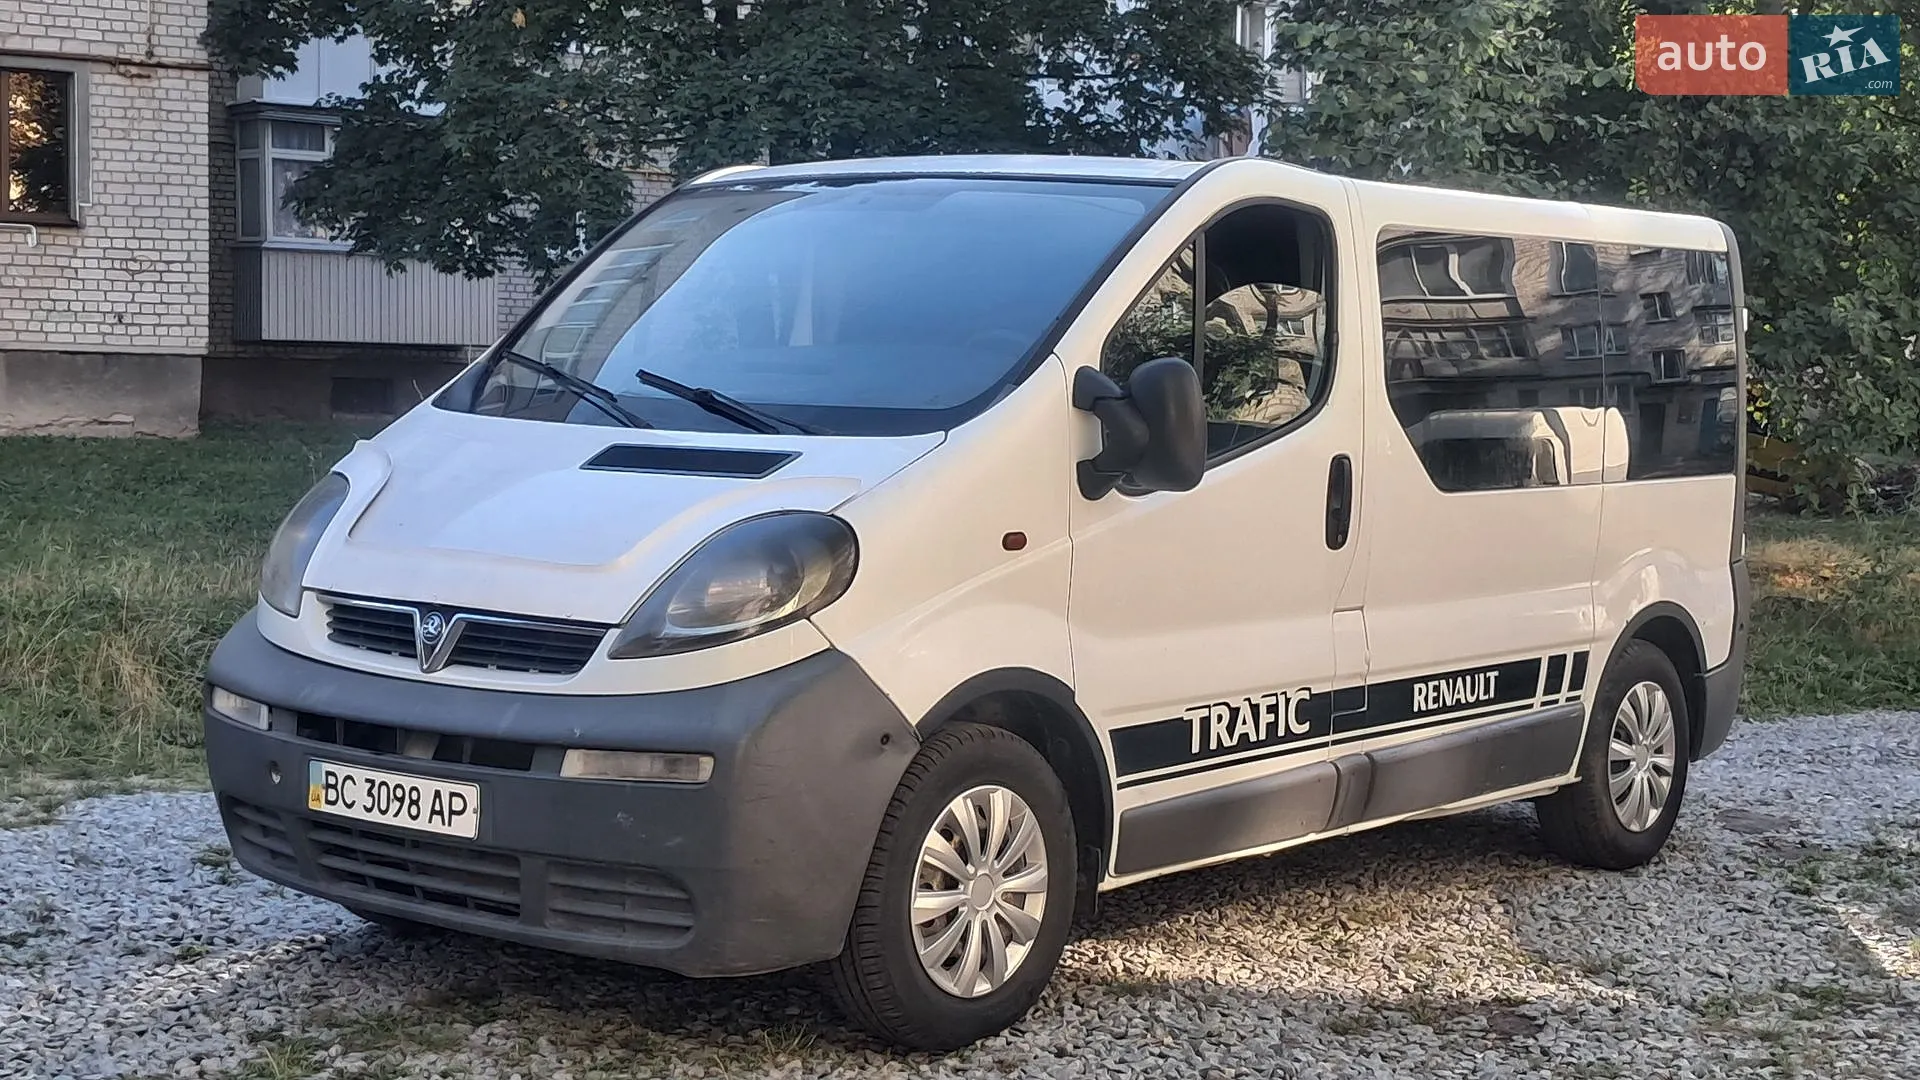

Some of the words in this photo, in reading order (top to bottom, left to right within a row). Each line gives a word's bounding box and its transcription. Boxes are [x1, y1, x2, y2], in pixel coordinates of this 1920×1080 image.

[1413, 670, 1500, 712] RENAULT
[1182, 687, 1312, 754] TRAFIC
[324, 770, 357, 809] BC
[362, 777, 421, 821] 3098
[428, 789, 468, 827] AP
